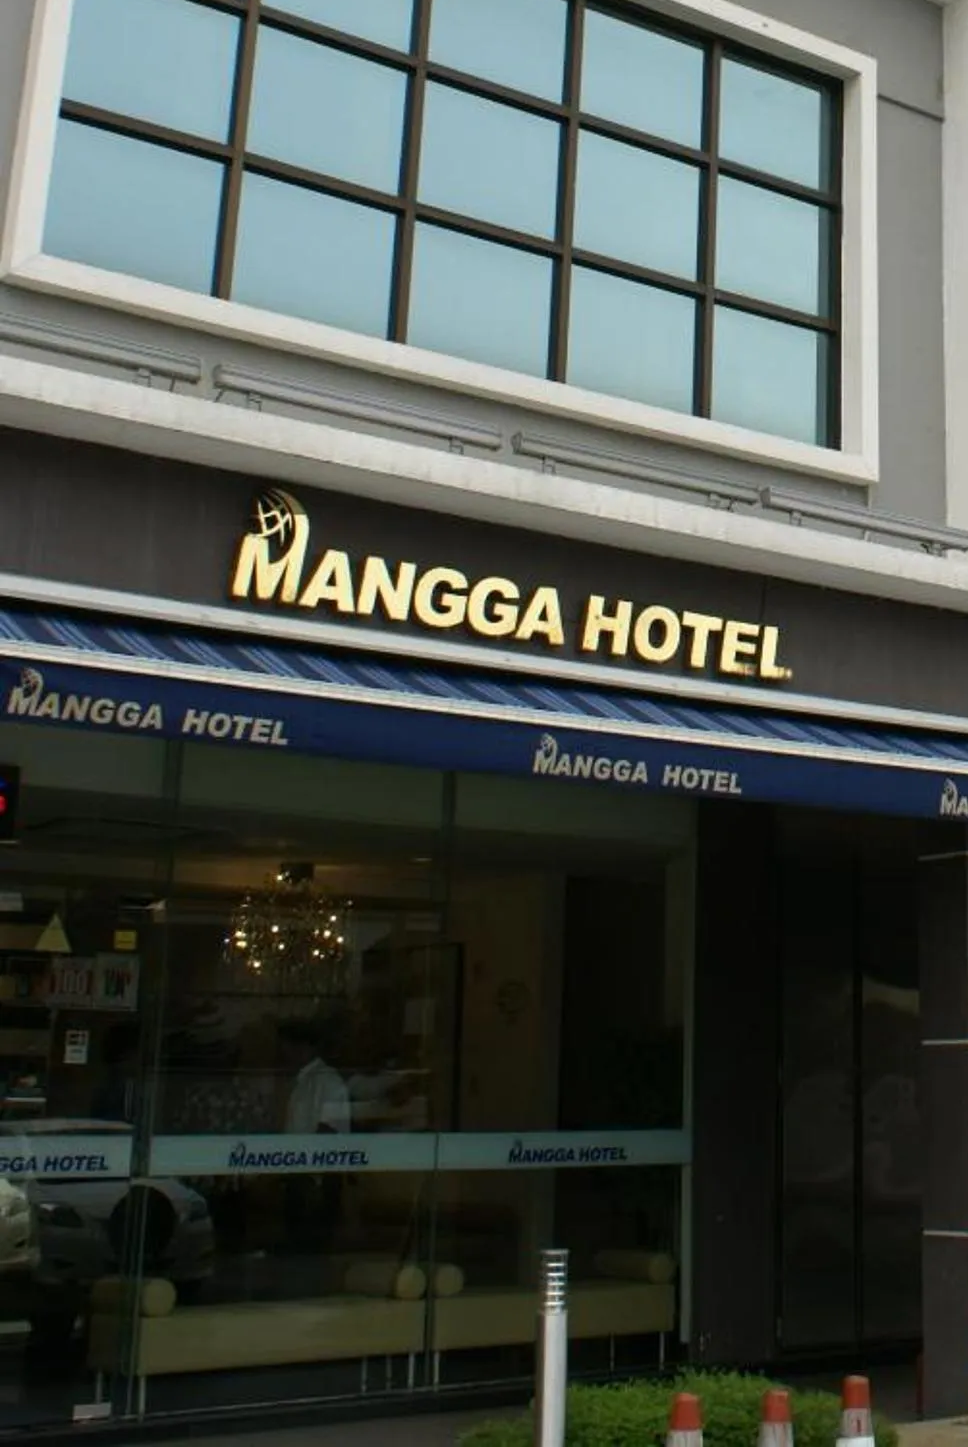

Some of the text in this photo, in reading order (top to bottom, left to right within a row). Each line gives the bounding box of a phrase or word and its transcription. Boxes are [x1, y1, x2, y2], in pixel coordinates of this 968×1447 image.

[231, 494, 793, 681] MANGGA HOTEL
[7, 672, 289, 746] MANGGA HOTEL
[531, 737, 743, 795] MANGGA HOTEL
[43, 1154, 109, 1172] HOTEL
[228, 1144, 369, 1168] MANGGA HOTEL
[508, 1142, 629, 1164] MANGGA HOTEL
